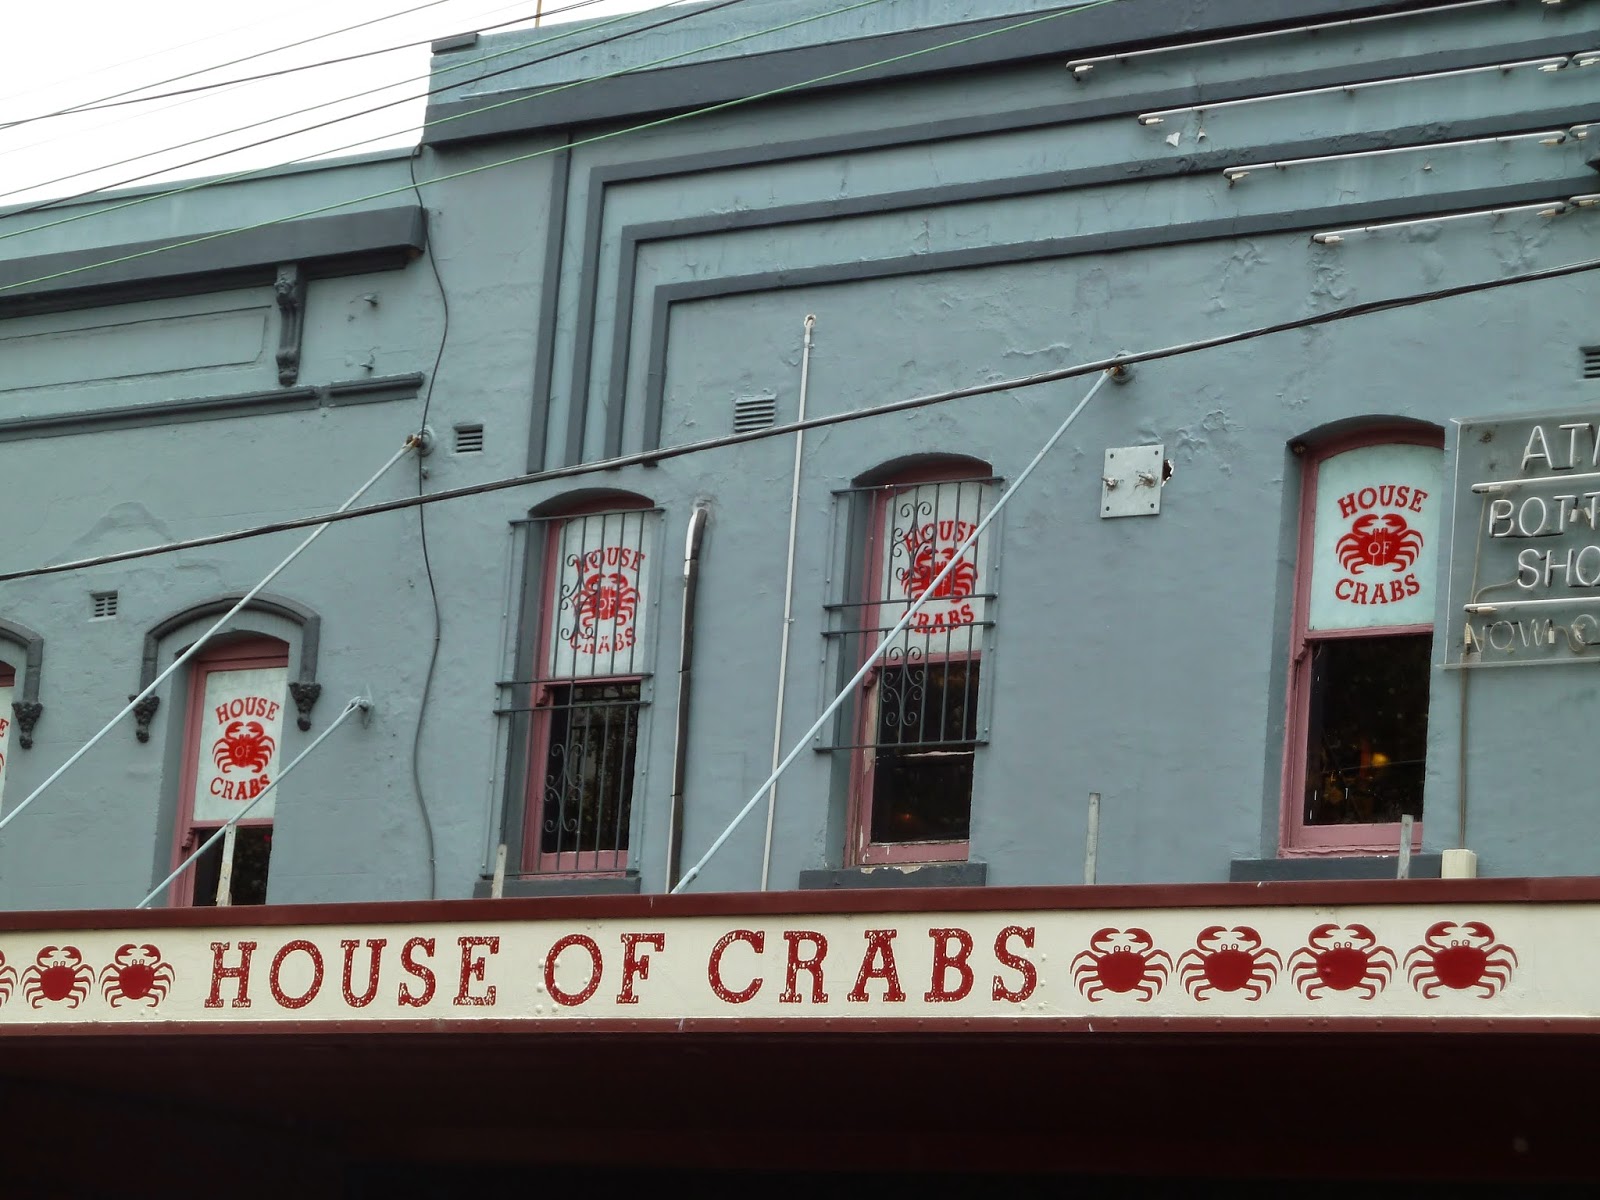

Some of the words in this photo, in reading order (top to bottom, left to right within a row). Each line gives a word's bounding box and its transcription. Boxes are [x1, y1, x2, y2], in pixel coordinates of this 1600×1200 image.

[1337, 484, 1429, 519] HOUSE
[573, 546, 646, 574] HOUSE
[1367, 540, 1392, 557] OF
[1335, 572, 1421, 605] CRABS
[215, 696, 280, 725] HOUSE
[234, 744, 253, 759] OF
[204, 937, 500, 1009] HOUSE
[544, 932, 665, 1007] OF
[708, 926, 1037, 1004] CRABS
